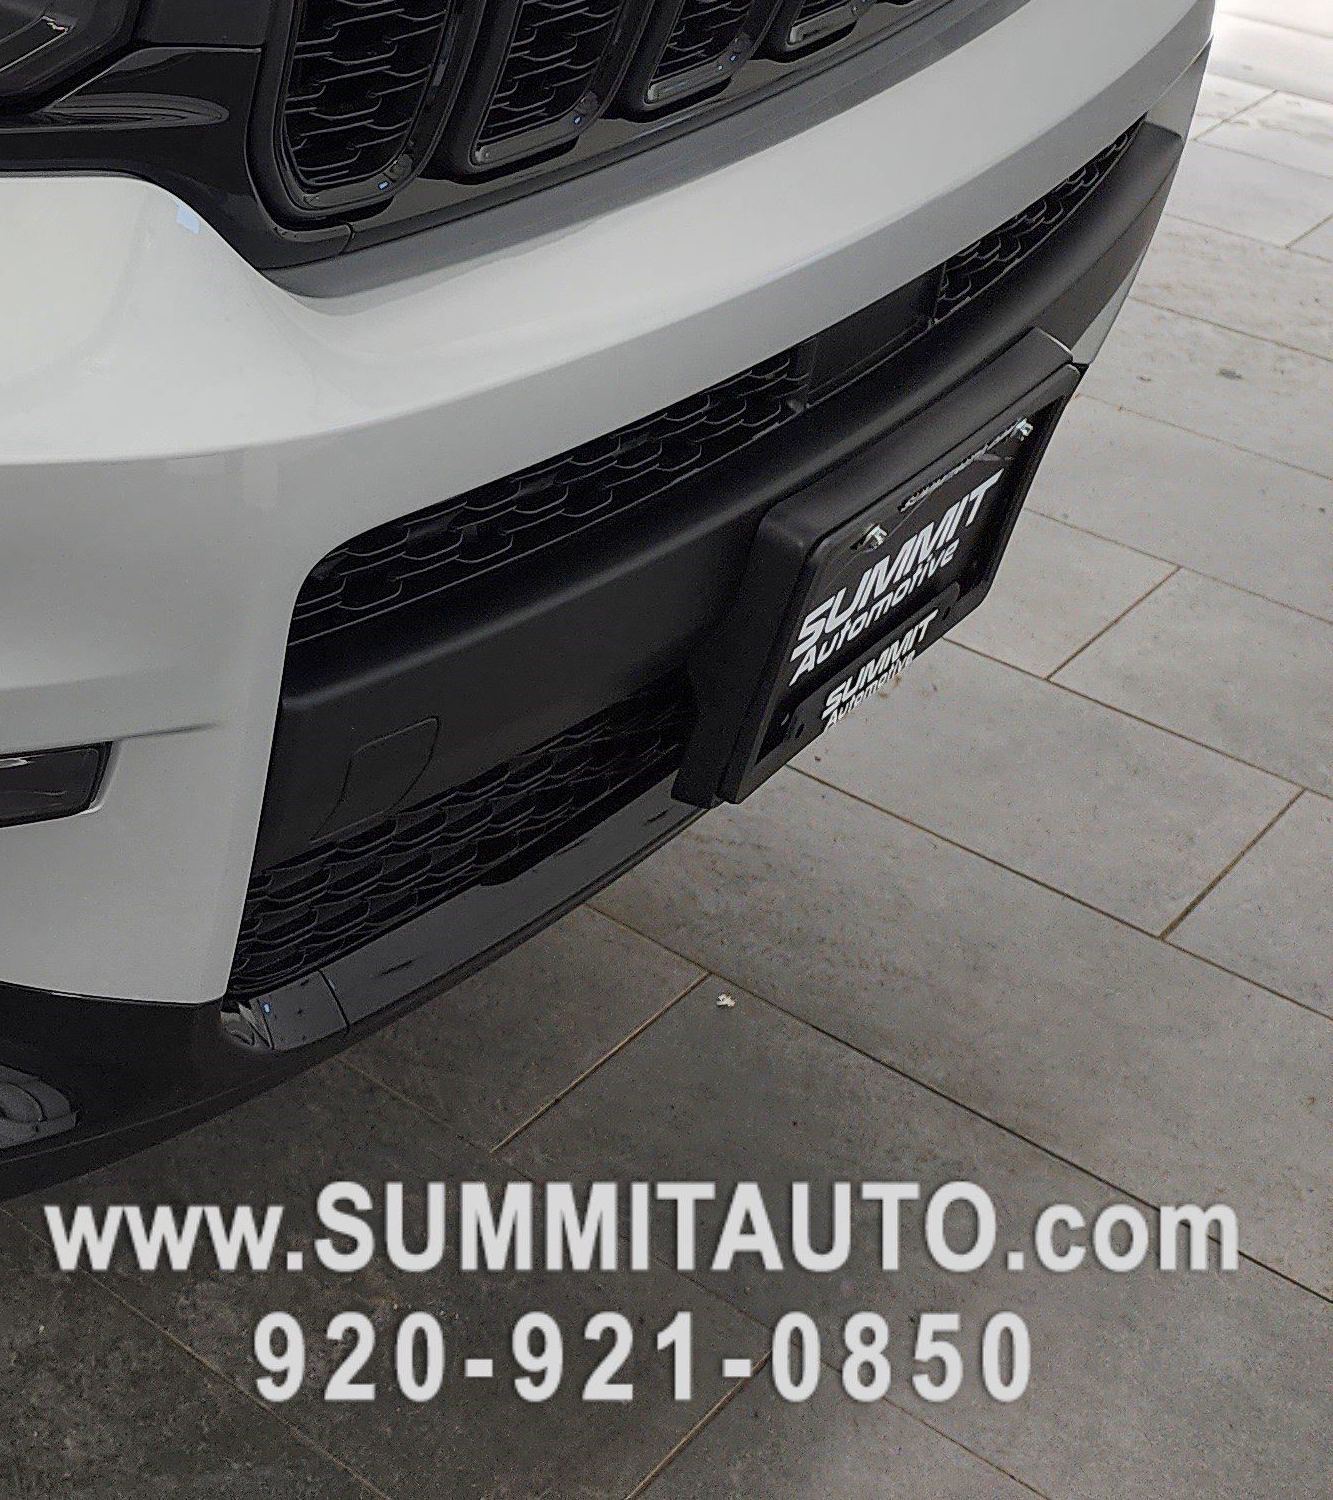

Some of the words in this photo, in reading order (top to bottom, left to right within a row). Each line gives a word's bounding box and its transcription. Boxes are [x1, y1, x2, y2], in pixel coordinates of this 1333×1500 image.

[789, 538, 960, 687] Automotive
[790, 468, 1004, 662] SUMMIT
[822, 609, 939, 720] SUMMIT
